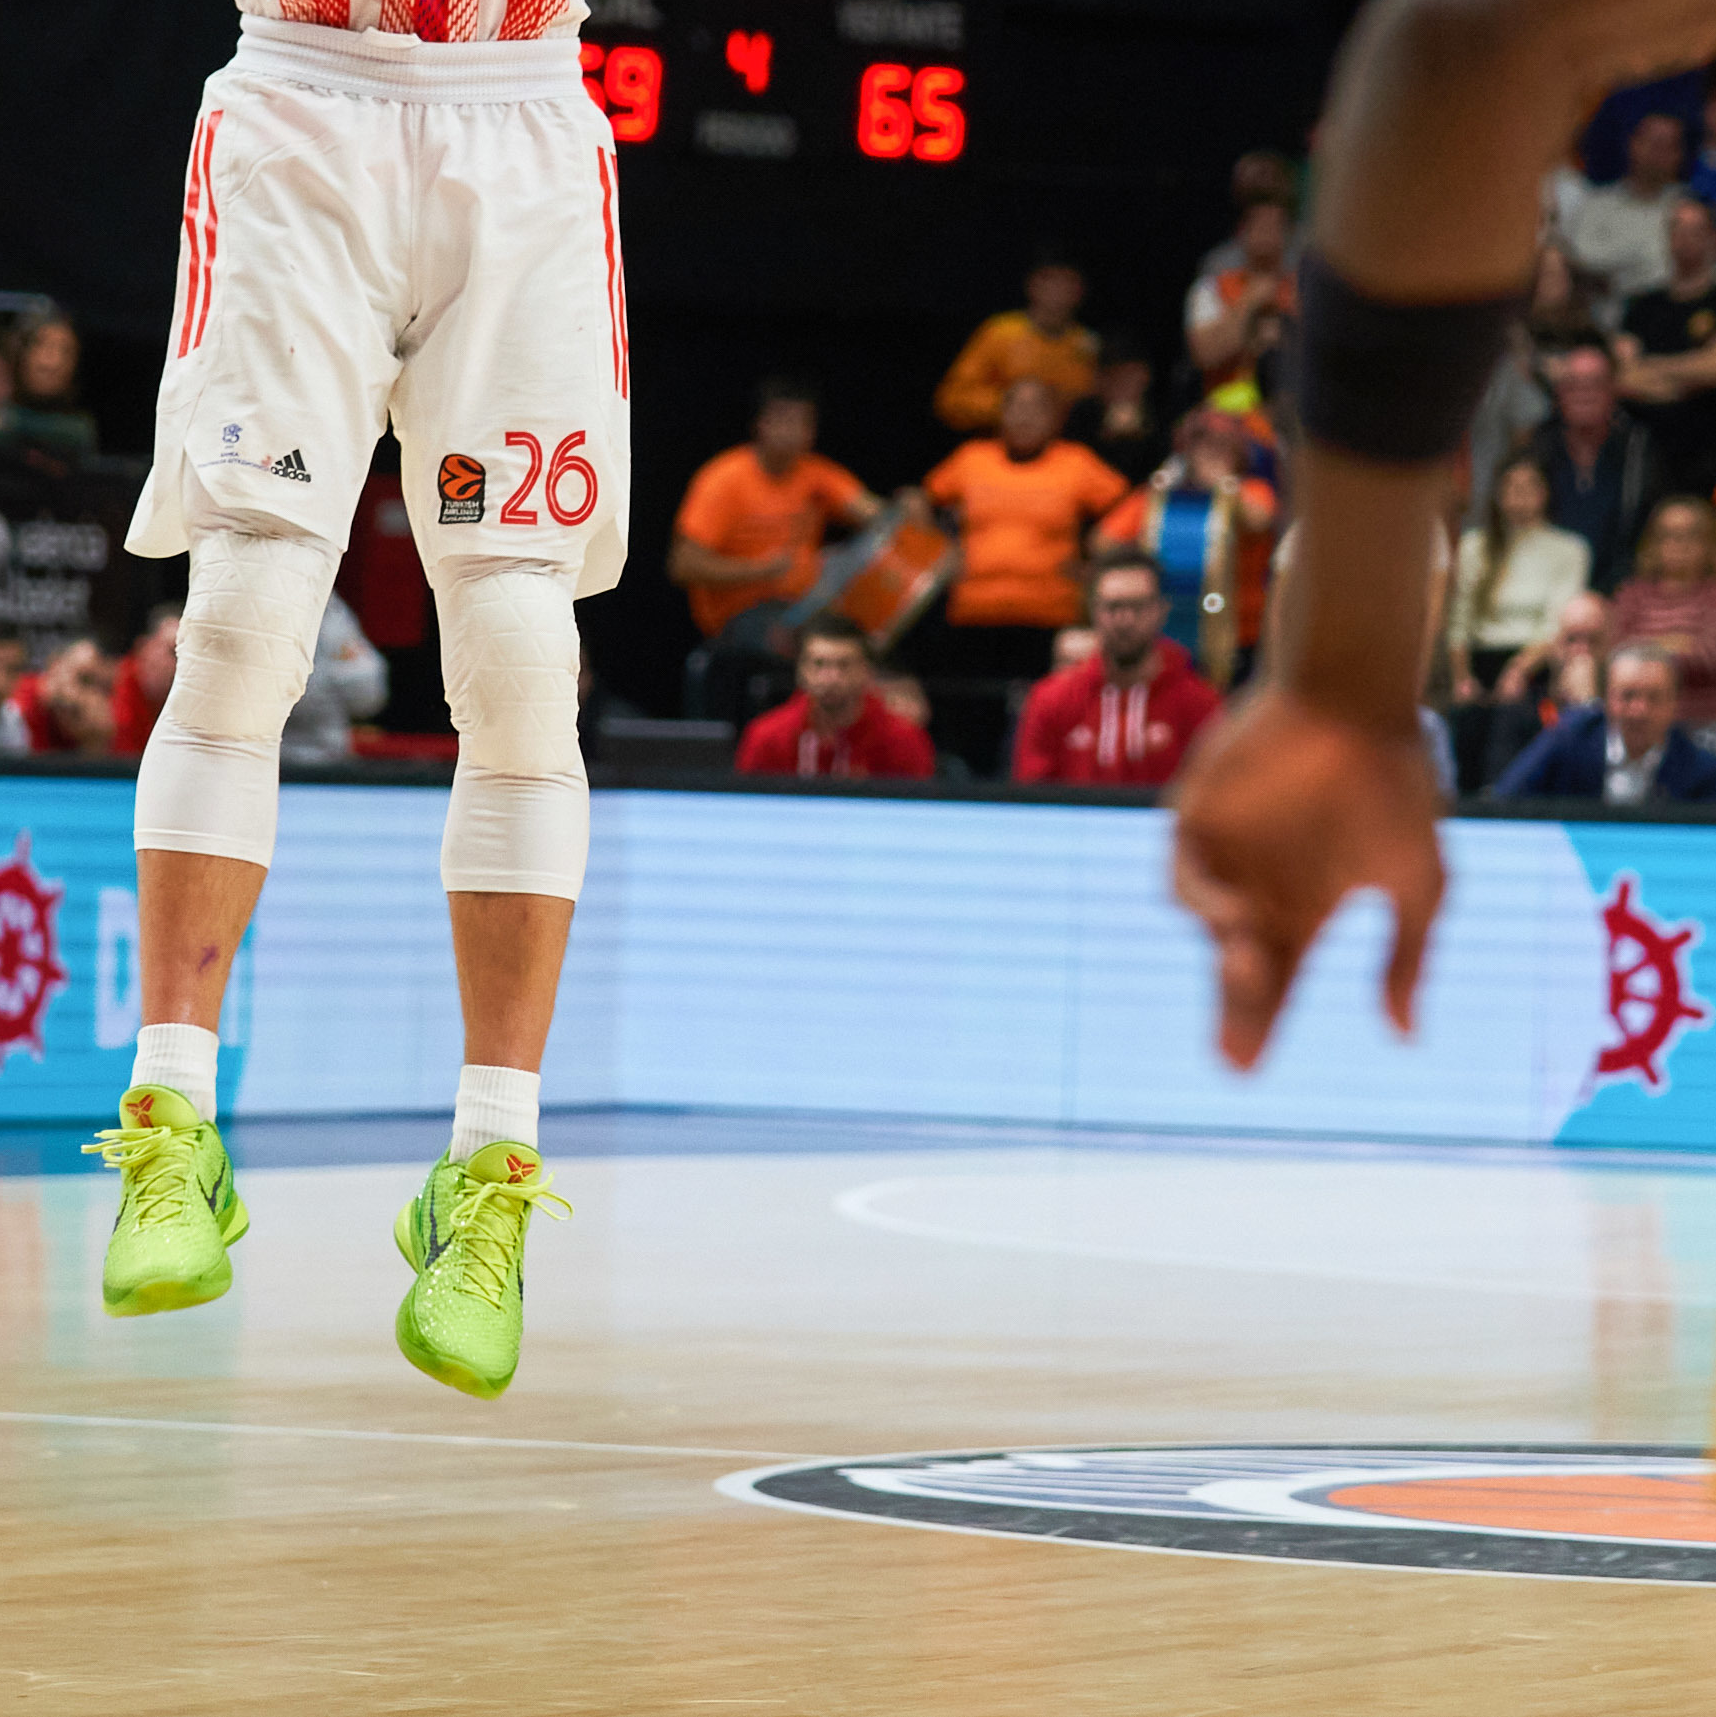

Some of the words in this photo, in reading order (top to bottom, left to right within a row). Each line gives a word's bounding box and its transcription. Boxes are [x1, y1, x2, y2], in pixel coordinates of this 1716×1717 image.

[858, 63, 967, 163] 65
[270, 465, 312, 484] adidas
[500, 430, 598, 526] 26
